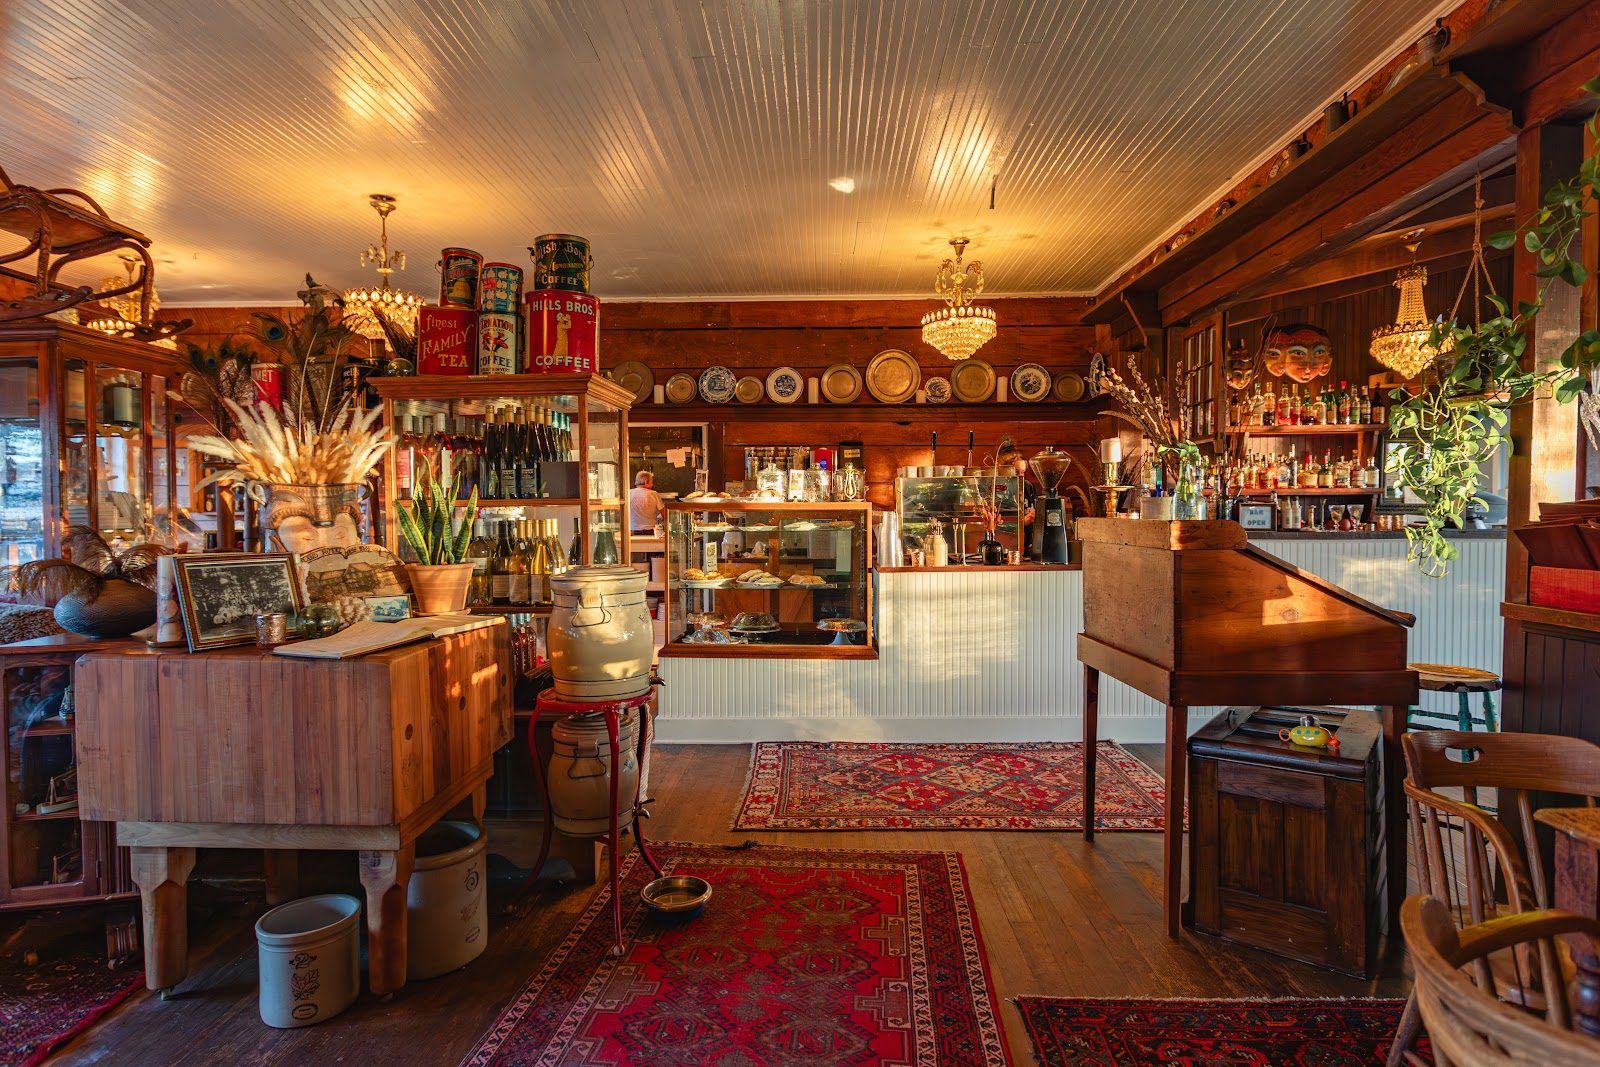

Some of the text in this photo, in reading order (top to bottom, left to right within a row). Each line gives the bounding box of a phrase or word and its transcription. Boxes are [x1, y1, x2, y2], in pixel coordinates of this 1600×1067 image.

[541, 273, 579, 286] COFFEE
[532, 300, 595, 316] HILLS BROS.
[420, 323, 475, 362] FAMILY
[438, 354, 469, 368] TEA
[535, 355, 591, 369] COFFEE
